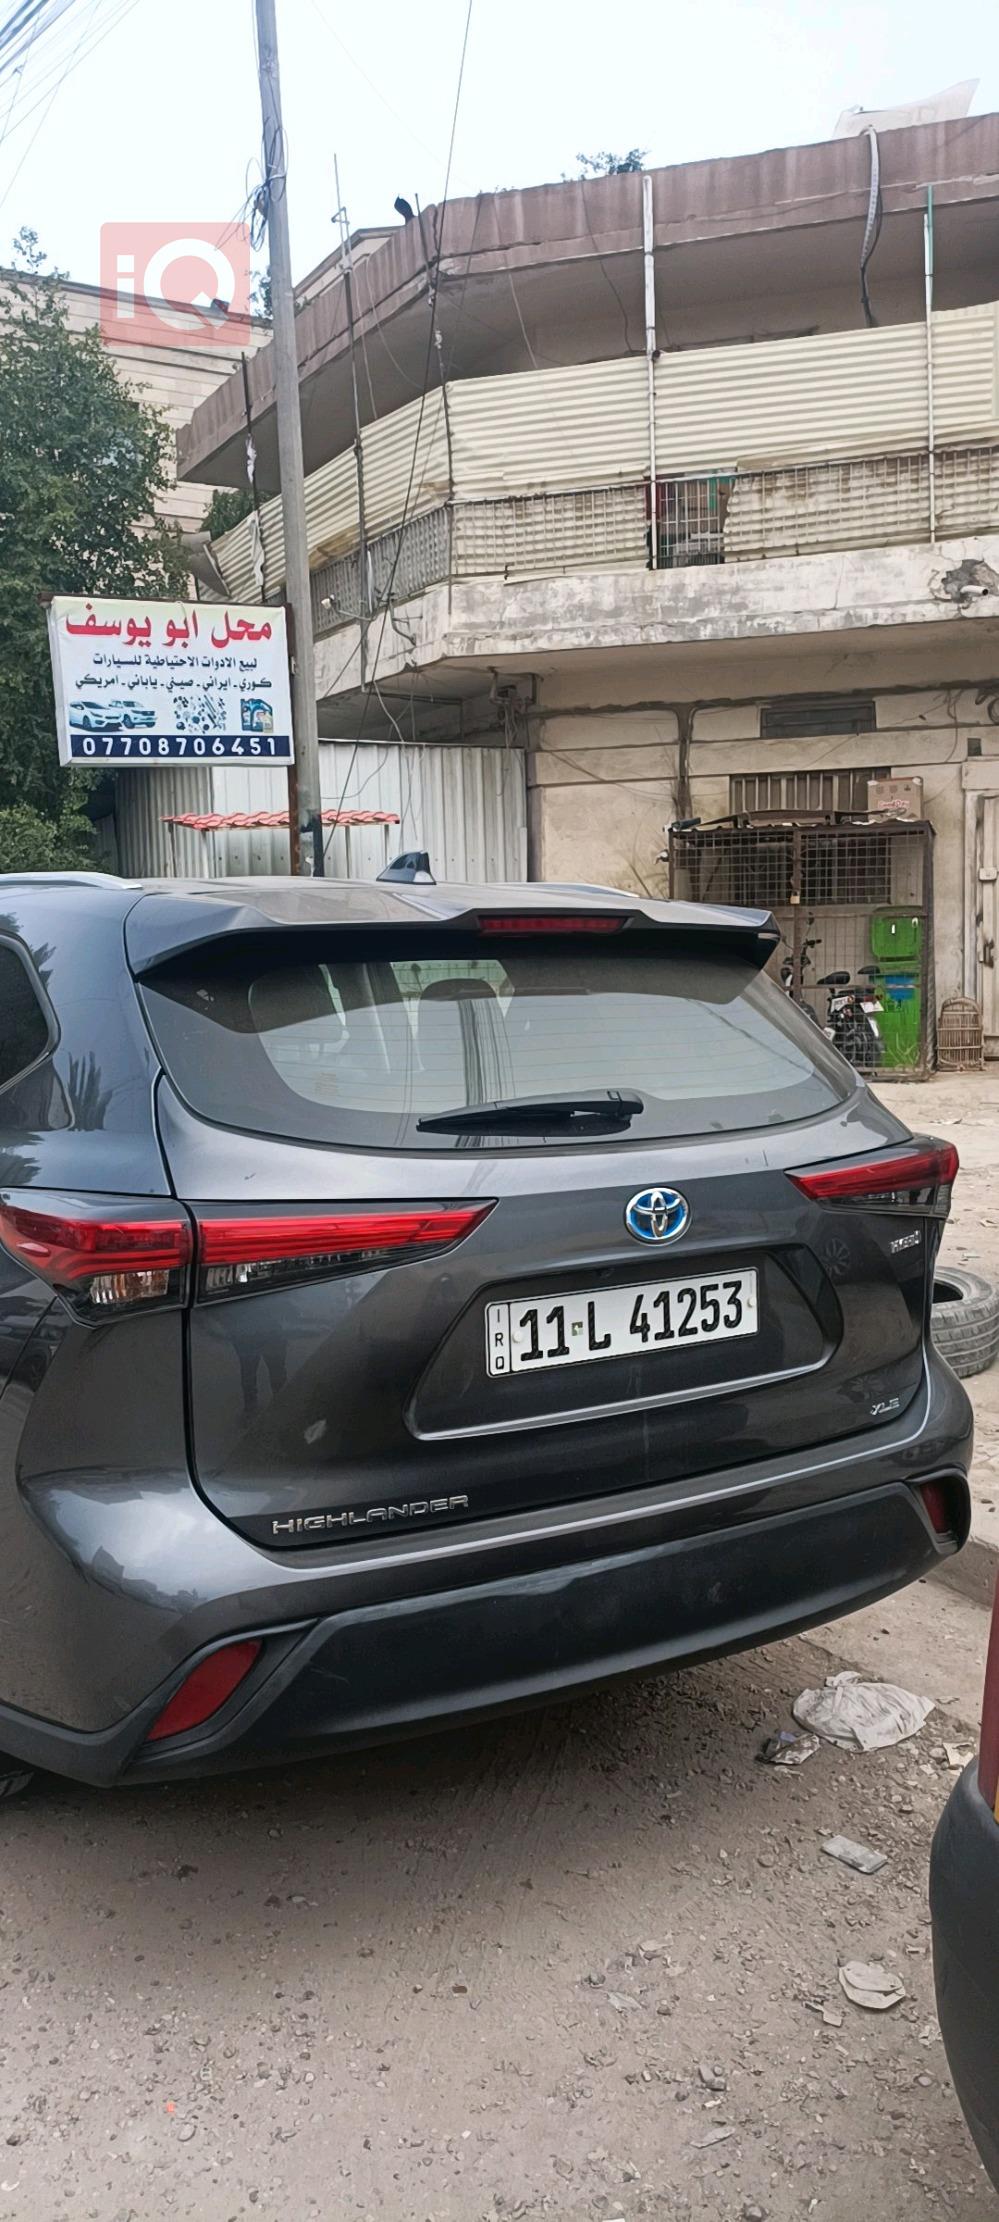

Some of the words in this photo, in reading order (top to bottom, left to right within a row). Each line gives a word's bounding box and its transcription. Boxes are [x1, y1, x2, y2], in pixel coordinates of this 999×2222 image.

[65, 602, 152, 648] يوسف
[162, 610, 198, 649] ابو
[211, 611, 272, 648] محل
[92, 652, 142, 668] للسيارات
[145, 654, 200, 668] الاحتياطية
[202, 656, 236, 668] الادوات
[239, 657, 257, 672] لبيع
[82, 737, 276, 756] 07708706451
[629, 1280, 743, 1343] 41253
[494, 1308, 504, 1371] IRQ
[870, 1397, 900, 1416] XLE
[272, 1494, 469, 1535] HIGHLANDER
